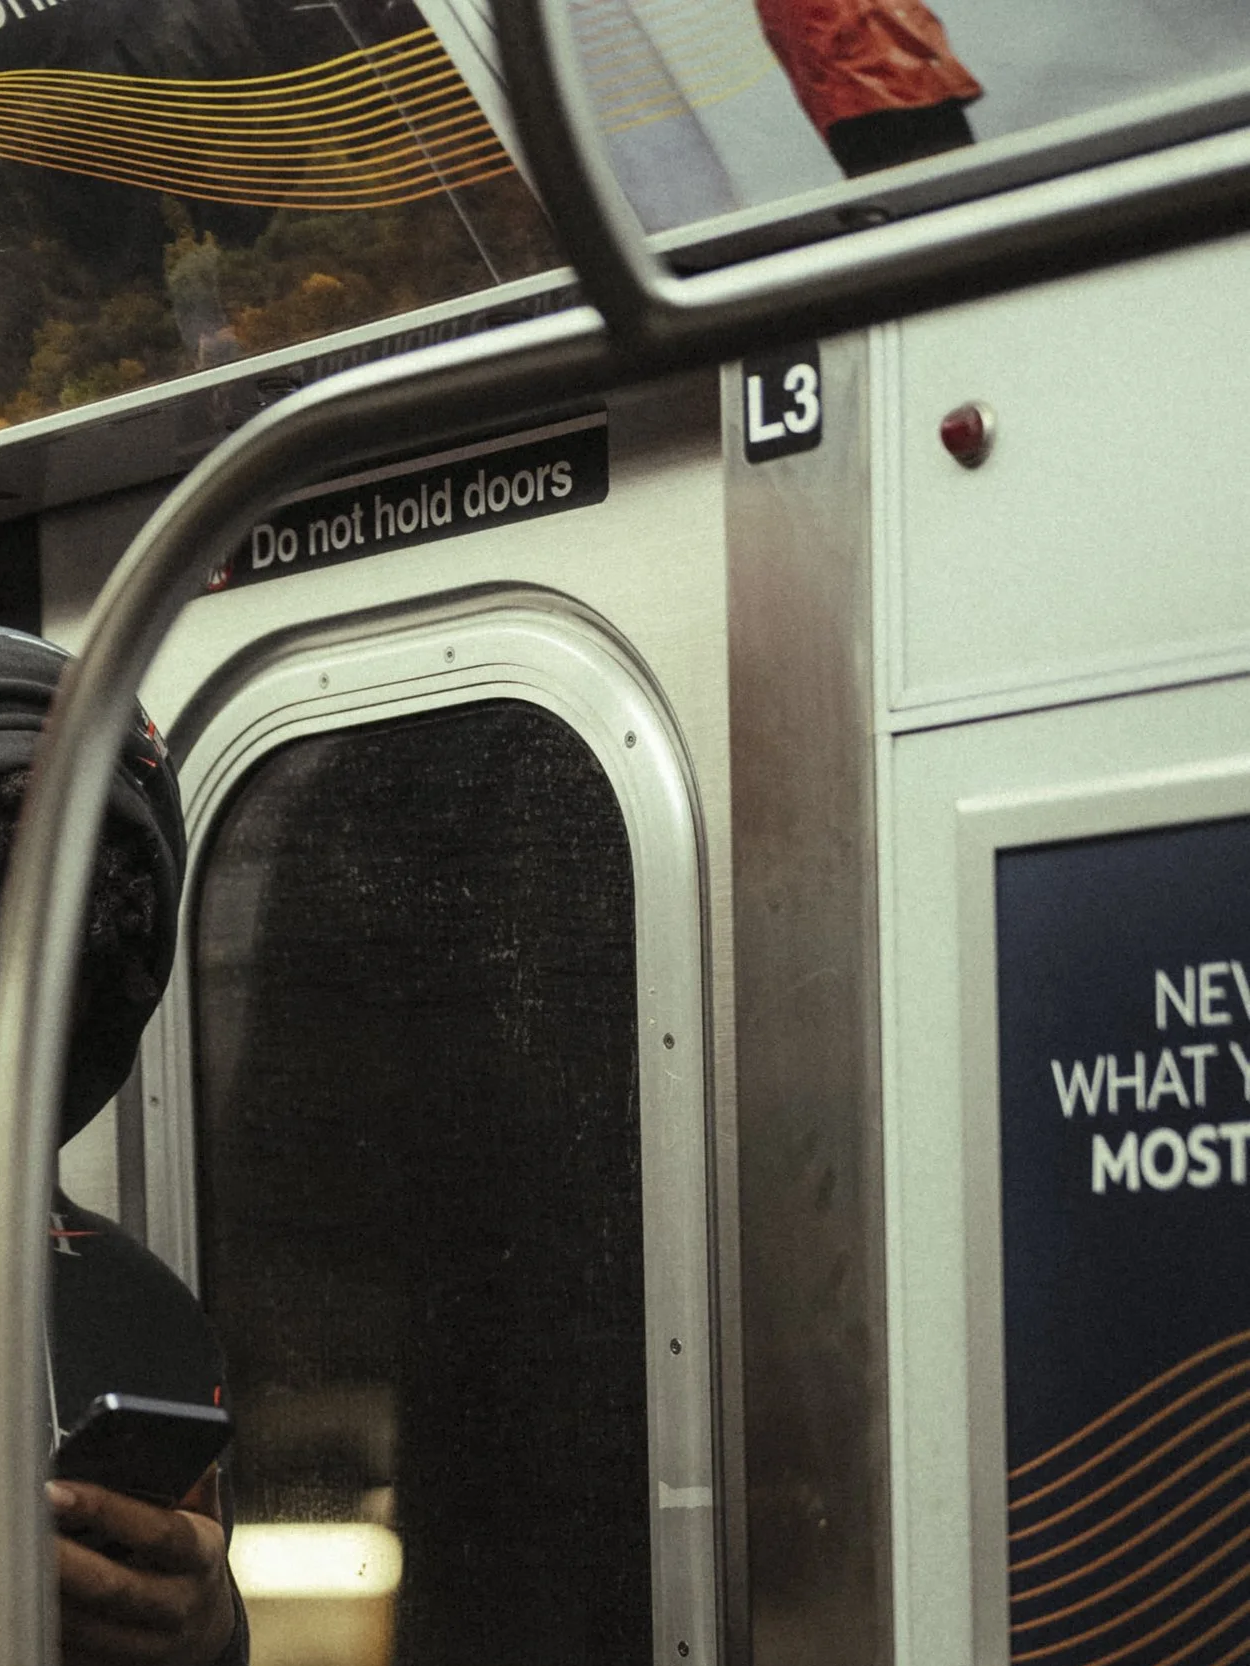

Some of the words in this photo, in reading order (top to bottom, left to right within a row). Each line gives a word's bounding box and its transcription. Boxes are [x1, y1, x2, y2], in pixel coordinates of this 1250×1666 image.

[746, 362, 820, 443] L3
[252, 523, 298, 569] Do
[308, 509, 365, 556] not
[374, 477, 453, 541] hold
[463, 459, 574, 518] doors
[1050, 1043, 1219, 1120] WHAT
[1091, 1121, 1250, 1195] MOST
